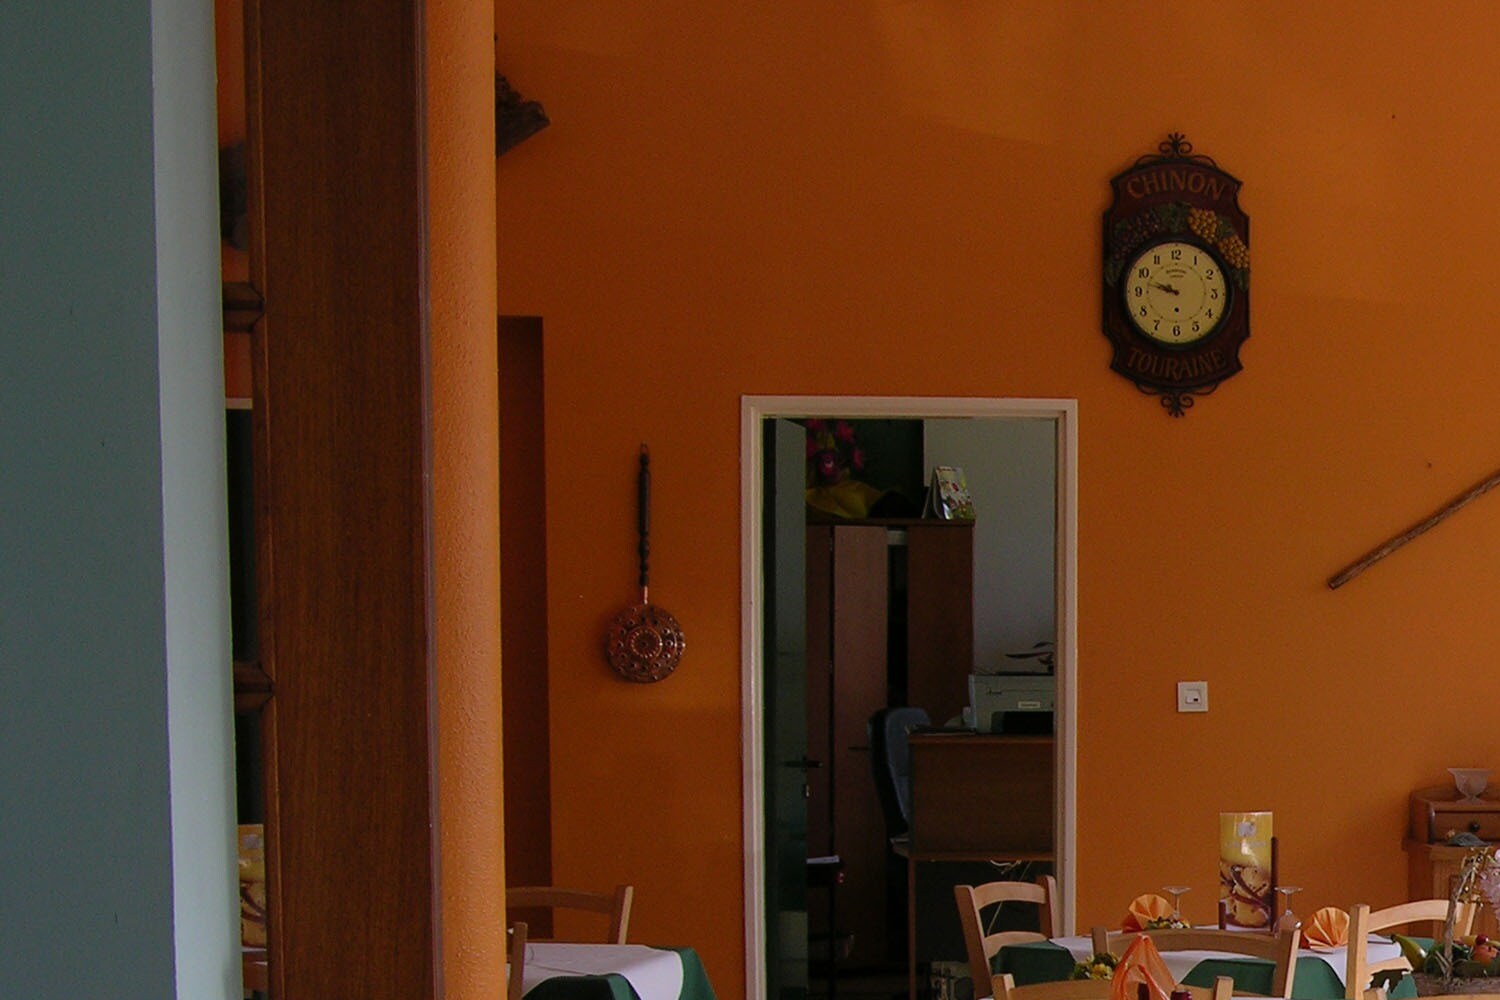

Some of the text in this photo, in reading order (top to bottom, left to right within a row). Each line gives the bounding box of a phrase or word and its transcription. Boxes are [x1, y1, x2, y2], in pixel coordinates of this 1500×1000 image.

[1127, 169, 1226, 201] CHINON
[1153, 255, 1160, 265] 11
[1171, 249, 1182, 260] 12
[1193, 255, 1197, 265] 1
[1138, 267, 1150, 278] 10
[1205, 268, 1214, 280] 2
[1134, 286, 1142, 297] 9
[1210, 288, 1218, 300] 3
[1139, 305, 1147, 316] 8
[1204, 308, 1212, 319] 4
[1153, 319, 1160, 331] 7
[1172, 325, 1181, 336] 6
[1191, 321, 1200, 332] 5
[1127, 347, 1227, 380] TOURAINE
